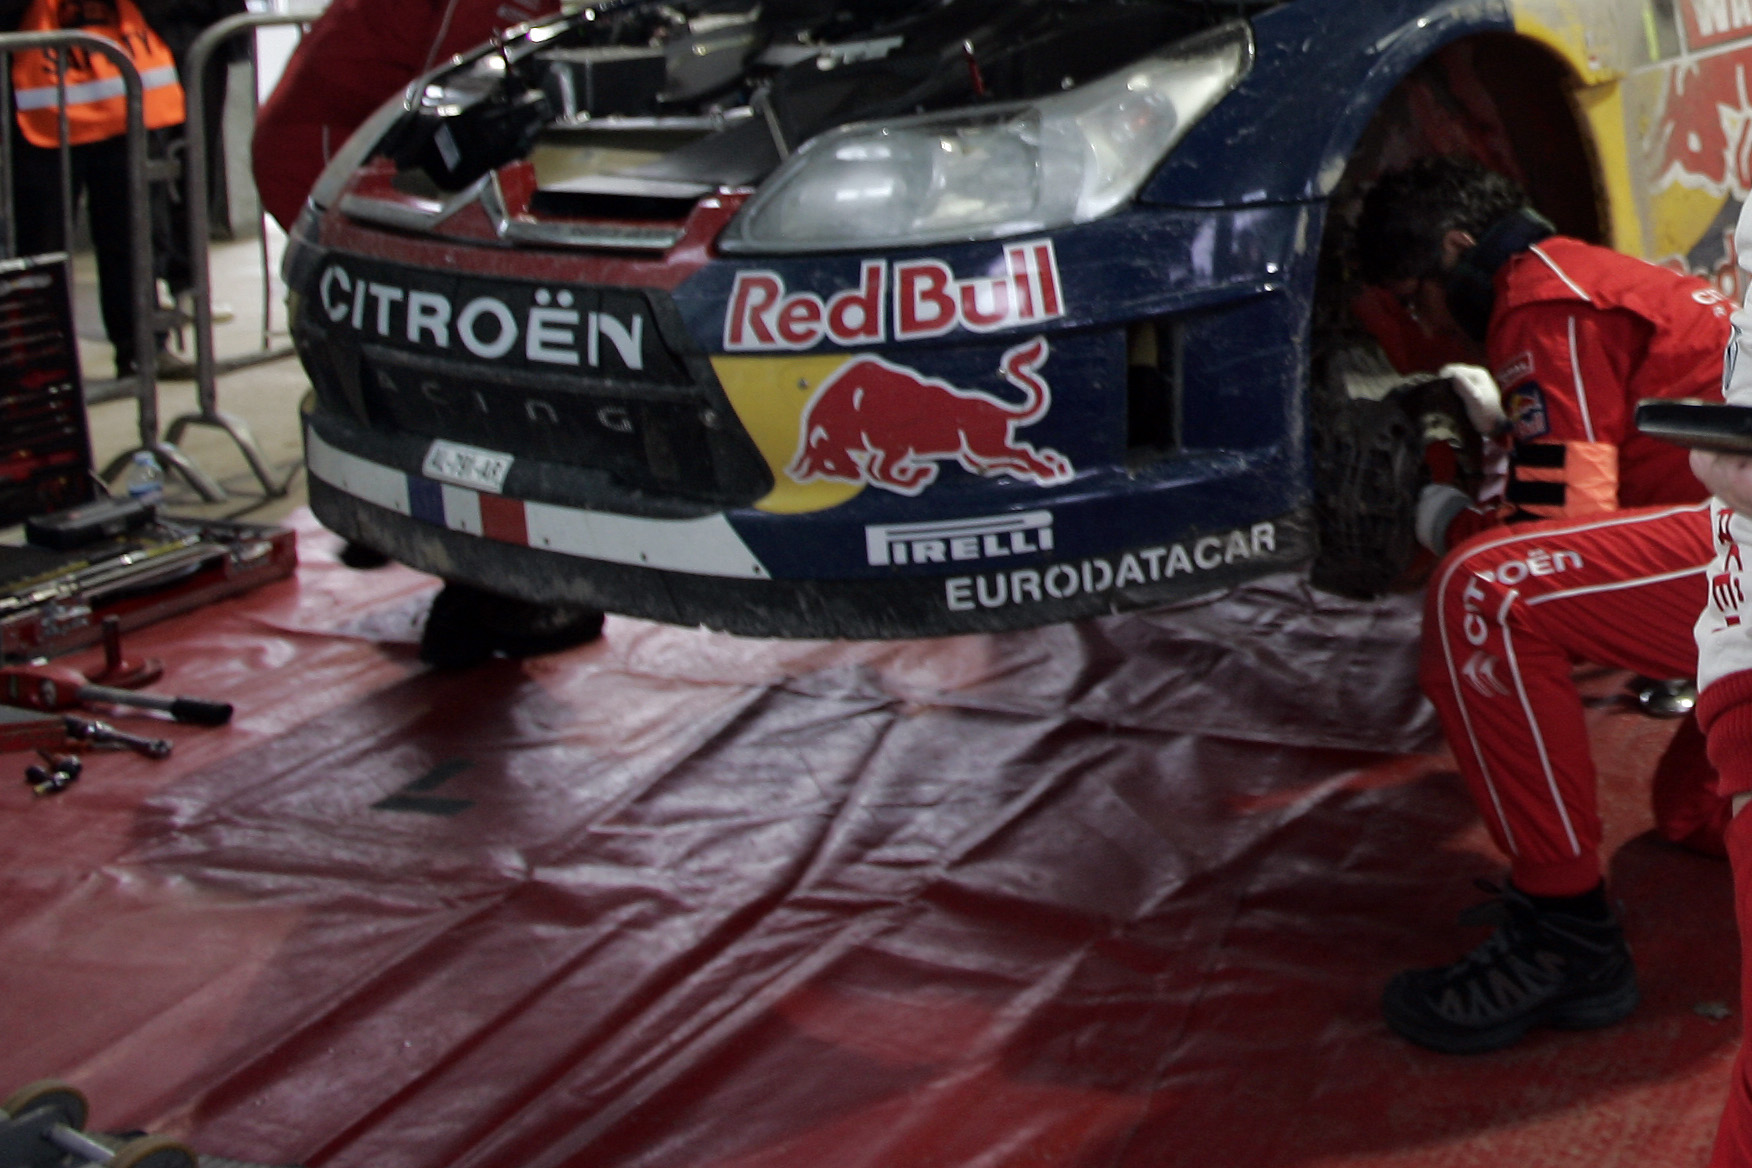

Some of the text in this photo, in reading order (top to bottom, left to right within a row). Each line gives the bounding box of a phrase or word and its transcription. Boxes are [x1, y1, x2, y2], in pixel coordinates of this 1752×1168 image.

[320, 264, 644, 371] CITROËN
[723, 237, 1066, 352] Red Bull
[865, 510, 1054, 567] PIRELLI
[944, 521, 1277, 612] EURODATACAR
